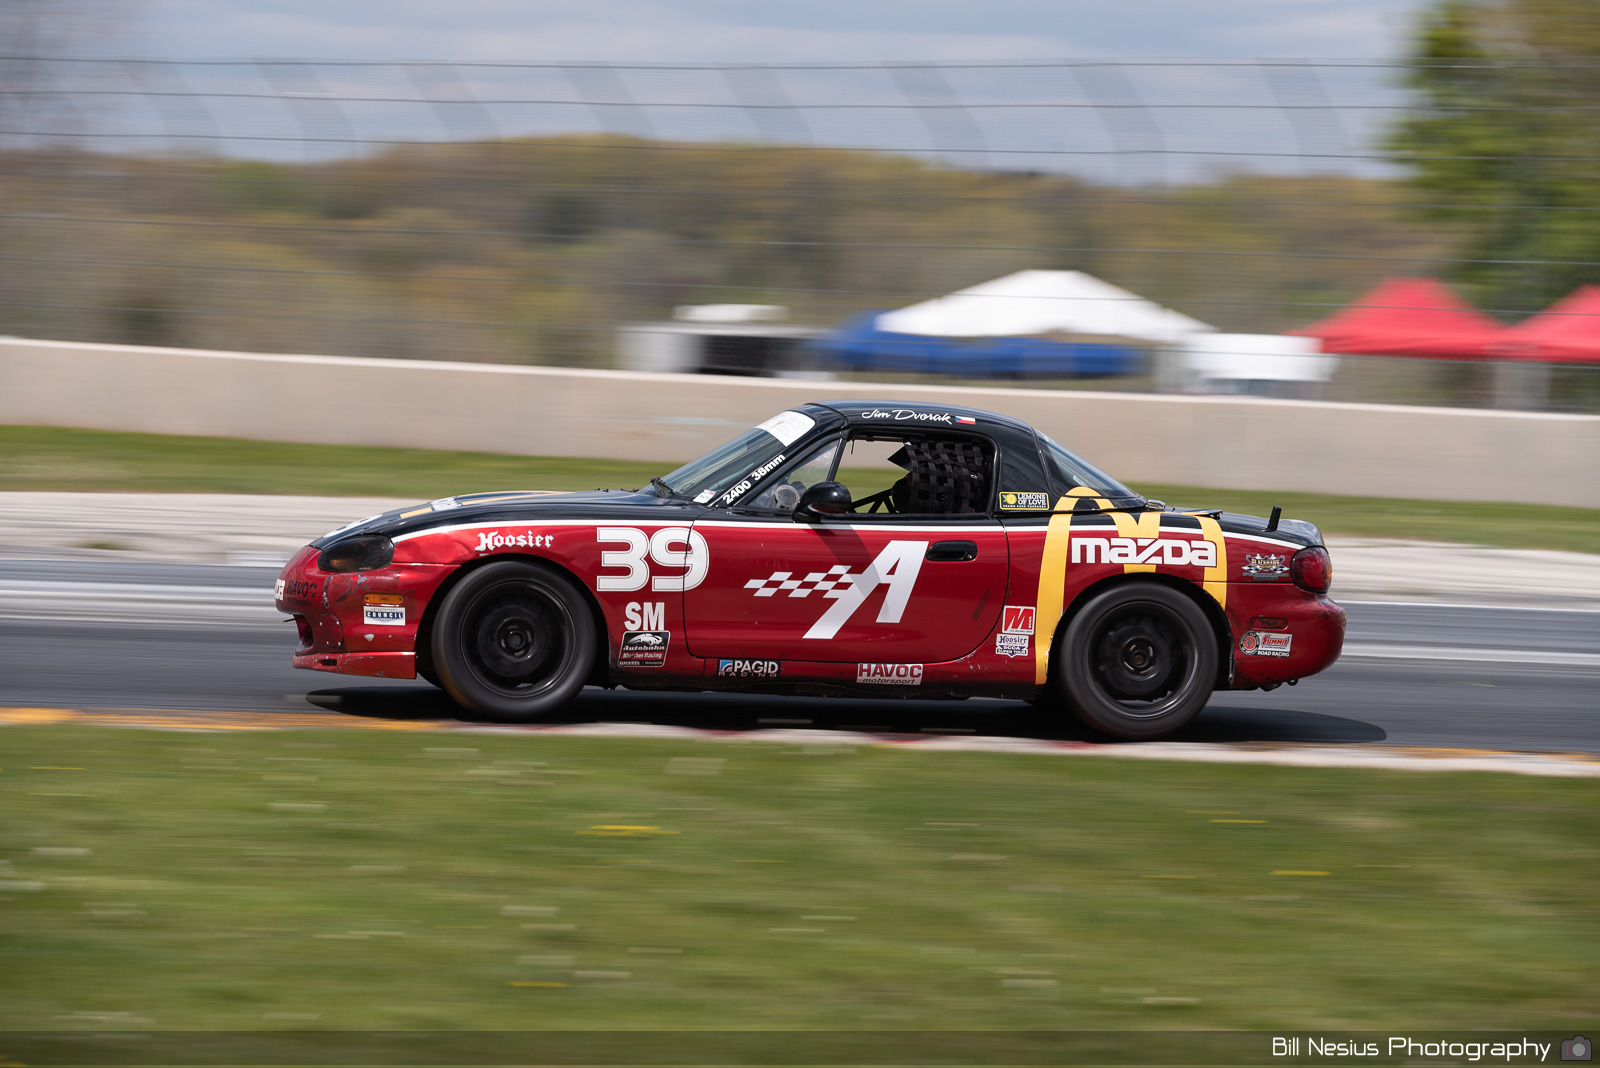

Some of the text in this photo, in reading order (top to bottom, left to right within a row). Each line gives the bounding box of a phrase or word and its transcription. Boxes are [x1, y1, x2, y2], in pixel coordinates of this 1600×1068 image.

[861, 408, 953, 425] Jim Dvorak
[722, 480, 752, 504] 2400
[751, 454, 786, 481] 38mm
[474, 530, 554, 552] Hoosier
[596, 527, 710, 592] 39
[623, 601, 665, 631] SM
[998, 635, 1028, 644] Hoosier
[644, 652, 663, 660] Racing
[734, 660, 779, 674] PAGID
[858, 663, 922, 678] HAVOC
